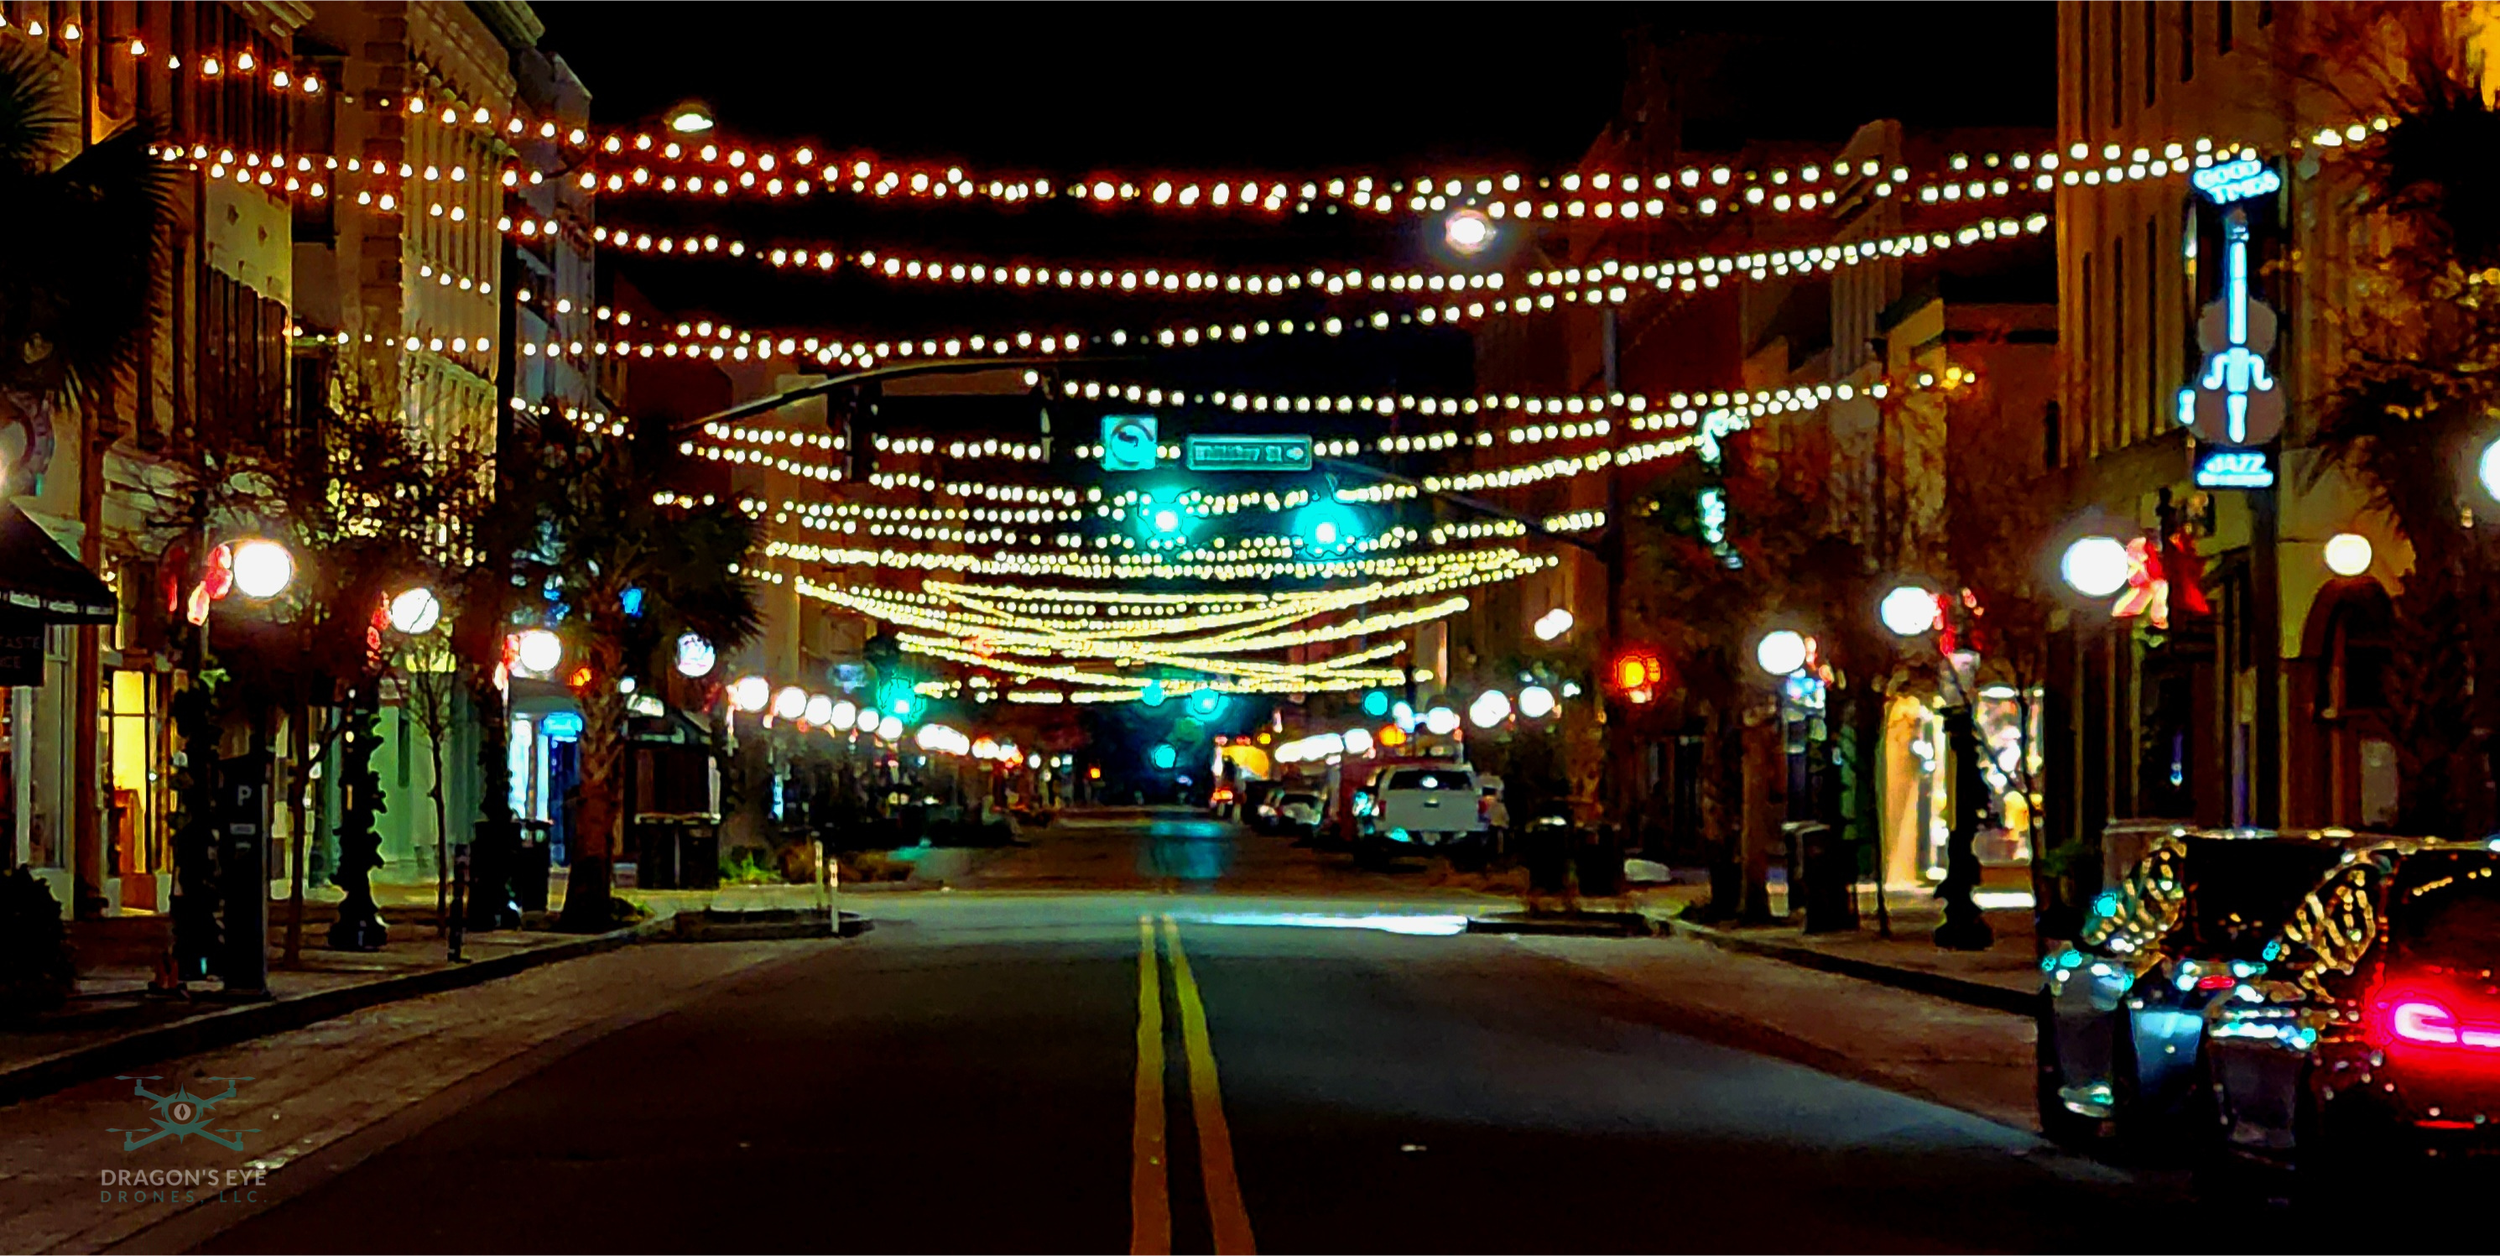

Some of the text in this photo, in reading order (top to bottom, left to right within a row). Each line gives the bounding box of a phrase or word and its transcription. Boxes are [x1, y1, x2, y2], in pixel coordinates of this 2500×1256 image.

[2193, 159, 2261, 190] GOOD
[2205, 453, 2267, 472] JAZZ
[237, 785, 252, 806] P
